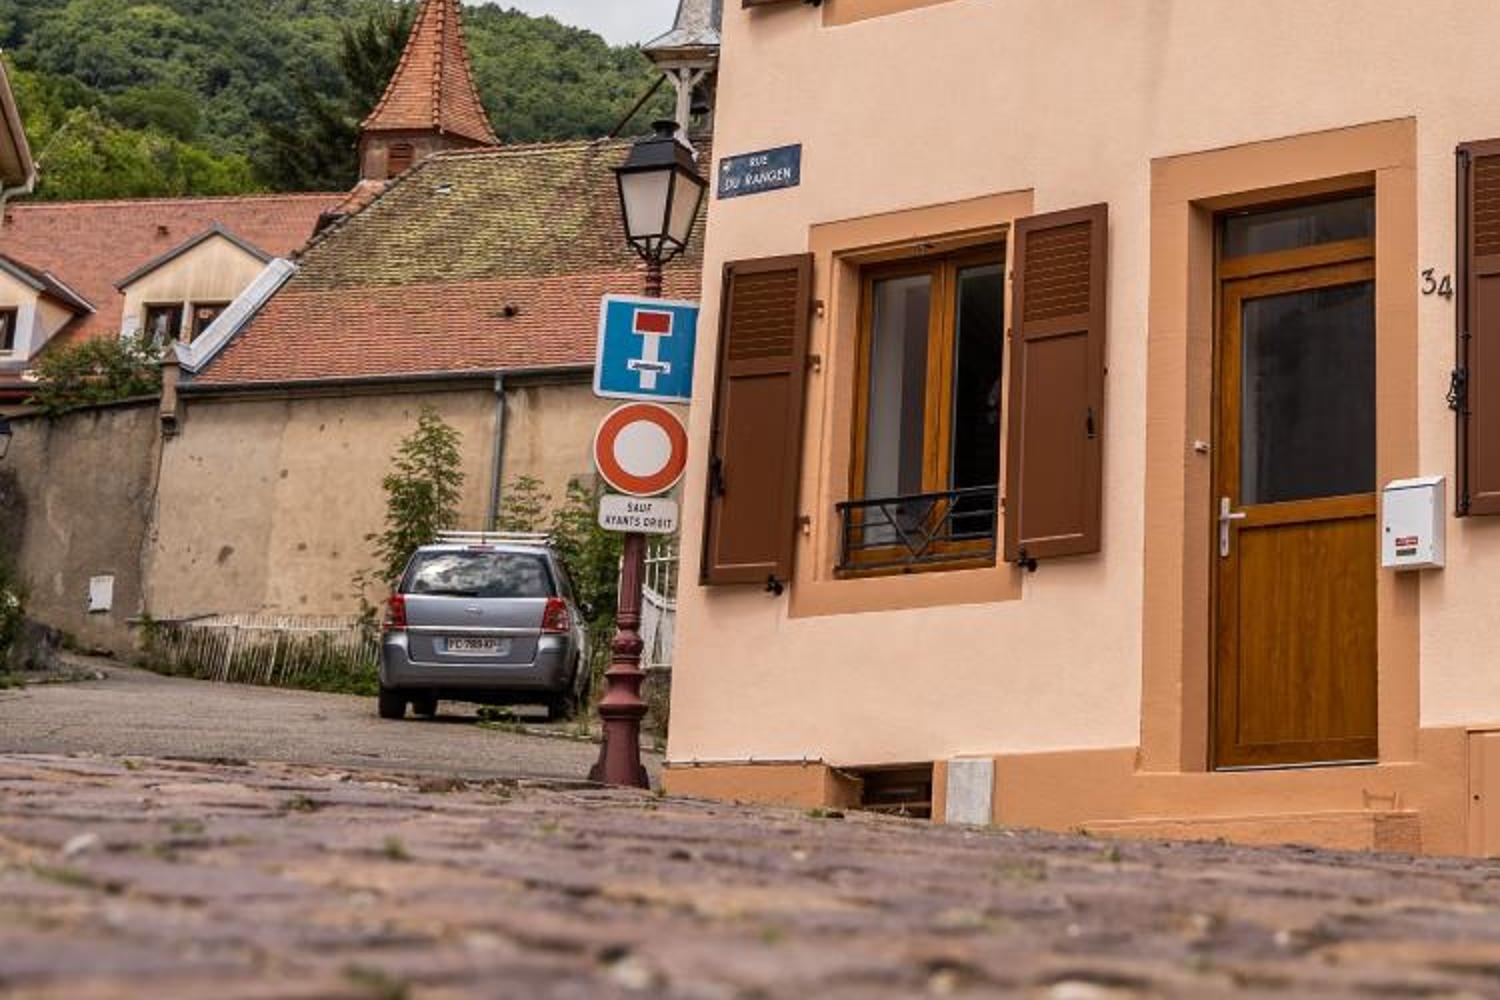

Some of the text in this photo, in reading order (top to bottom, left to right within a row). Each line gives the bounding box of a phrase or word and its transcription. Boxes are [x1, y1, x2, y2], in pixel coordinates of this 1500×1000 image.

[750, 155, 768, 166] RUE
[724, 167, 791, 191] DU RANGEN
[1421, 268, 1453, 301] 34
[627, 502, 653, 513] SAUF
[605, 515, 672, 529] AYANTS DROIT
